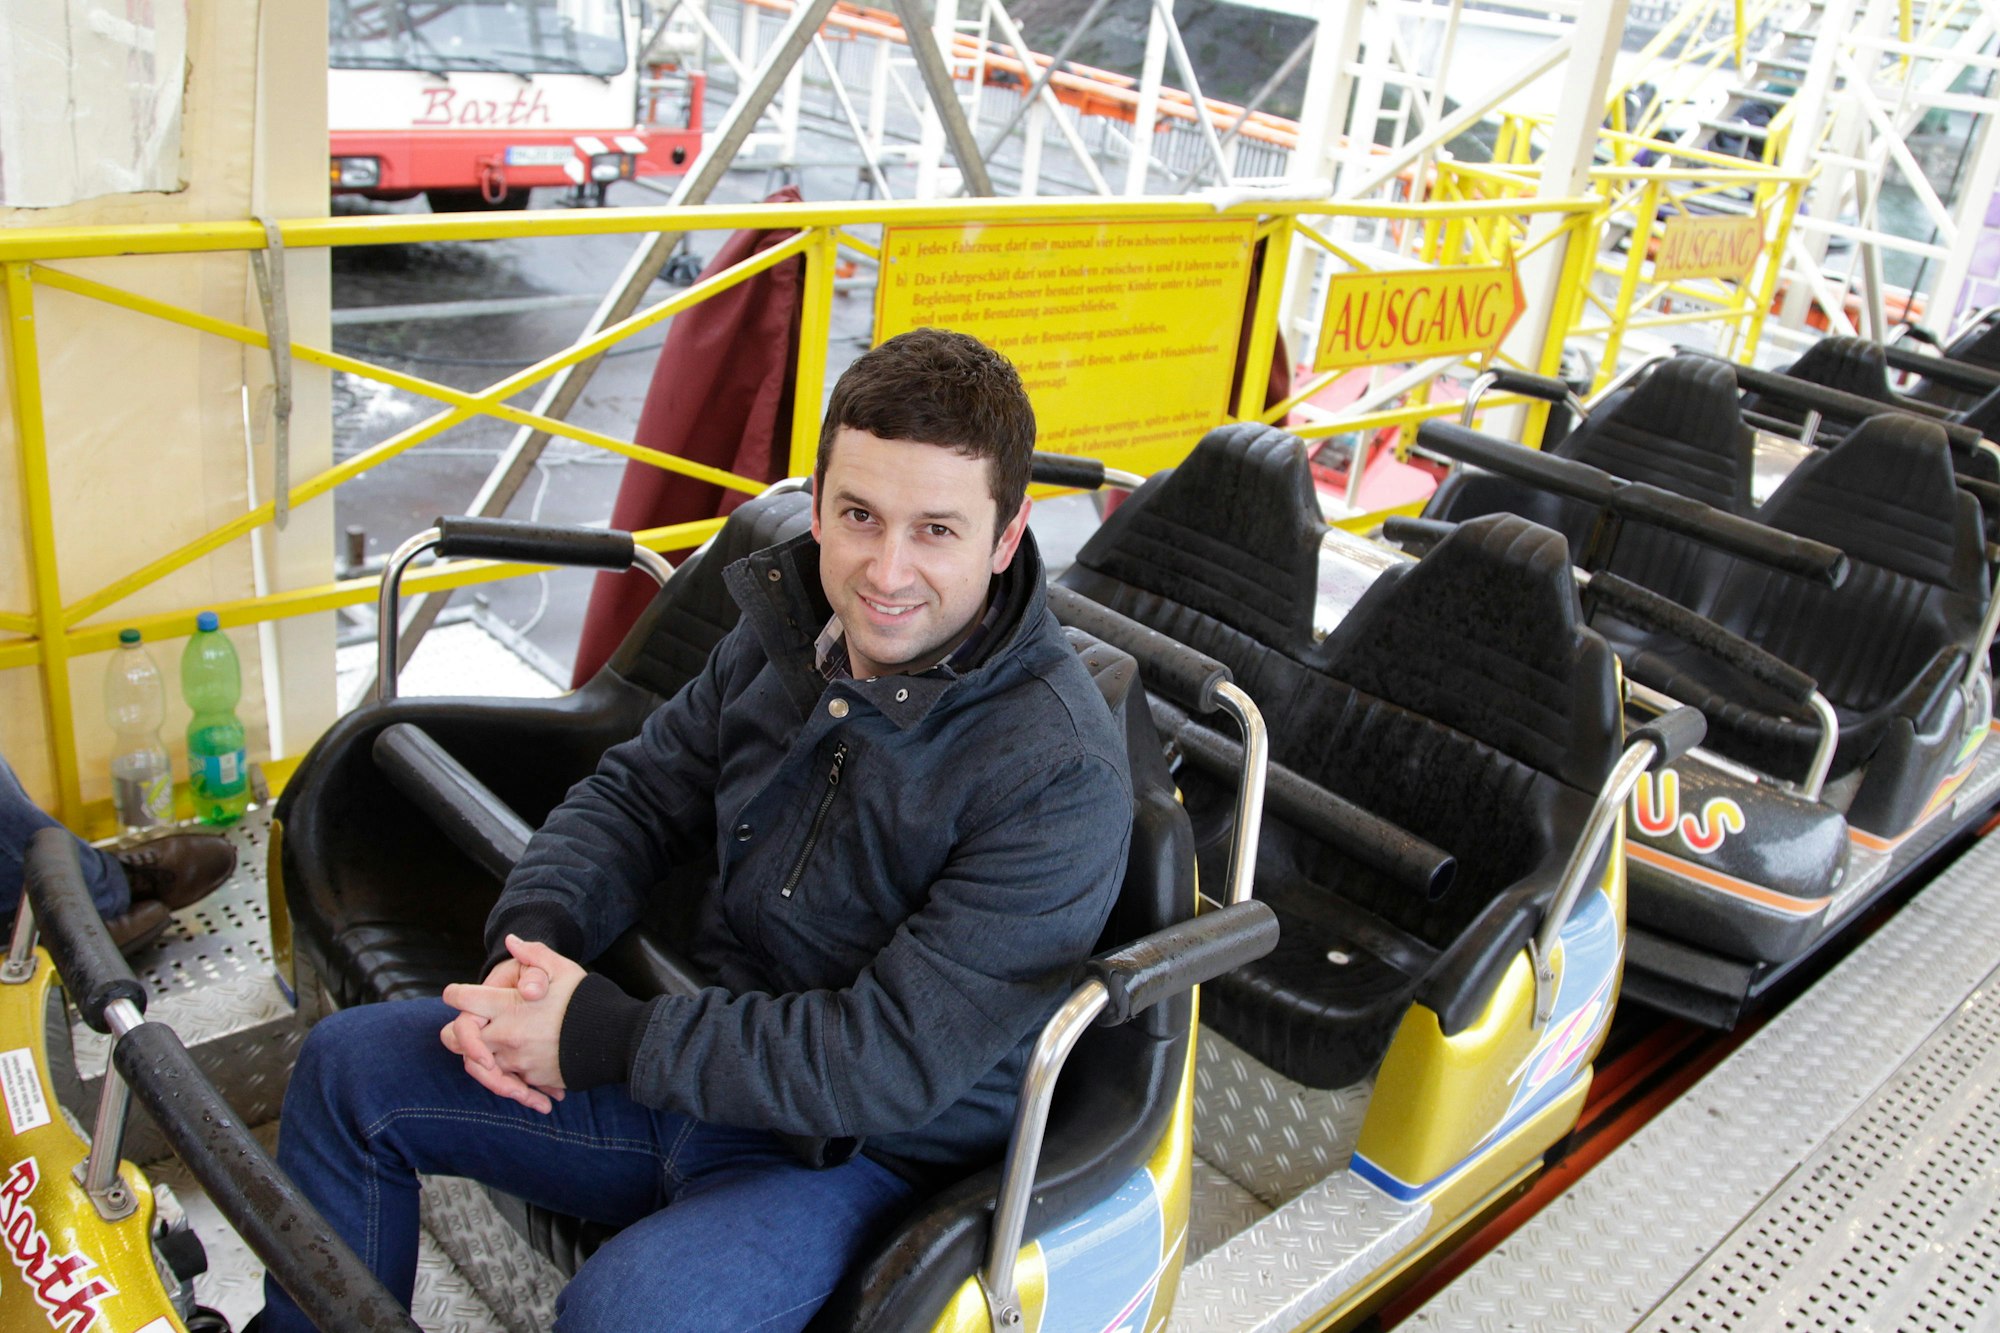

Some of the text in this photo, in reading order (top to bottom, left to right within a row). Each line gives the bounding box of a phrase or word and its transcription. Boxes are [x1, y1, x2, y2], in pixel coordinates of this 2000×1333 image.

[412, 88, 550, 125] Barth
[917, 241, 948, 257] Jedes
[1005, 237, 1028, 251] darf
[1030, 237, 1048, 250] mit
[1050, 235, 1094, 250] maximal
[1116, 233, 1177, 248] Erwachsenen
[1178, 232, 1211, 245] besetzt
[1661, 227, 1756, 271] AUSGANG
[914, 272, 937, 286] Das
[940, 268, 1010, 286] Fahrgeschäft
[1012, 266, 1036, 280] darf
[1037, 268, 1057, 279] von
[1059, 263, 1098, 278] Kindern
[1101, 262, 1145, 276] zwischen
[1155, 262, 1173, 273] und
[1184, 259, 1212, 273] Jahren
[912, 290, 973, 308] Begleitung
[975, 287, 1043, 302] Erwachsener
[1045, 282, 1085, 297] benutzt
[1128, 277, 1159, 292] Kinder
[1160, 277, 1185, 289] unter
[1194, 275, 1223, 289] Jahren
[911, 311, 936, 325] sind
[937, 312, 959, 323] von
[961, 308, 980, 322] der
[983, 306, 1040, 321] Benutzung
[1327, 282, 1502, 353] AUSGANG
[1000, 335, 1019, 348] von
[1021, 332, 1039, 346] der
[1041, 329, 1095, 345] Benutzung
[1036, 358, 1064, 372] Arme
[1065, 355, 1087, 369] und
[1118, 350, 1142, 364] oder
[1142, 347, 1159, 361] das
[0, 1157, 114, 1333] Barth
